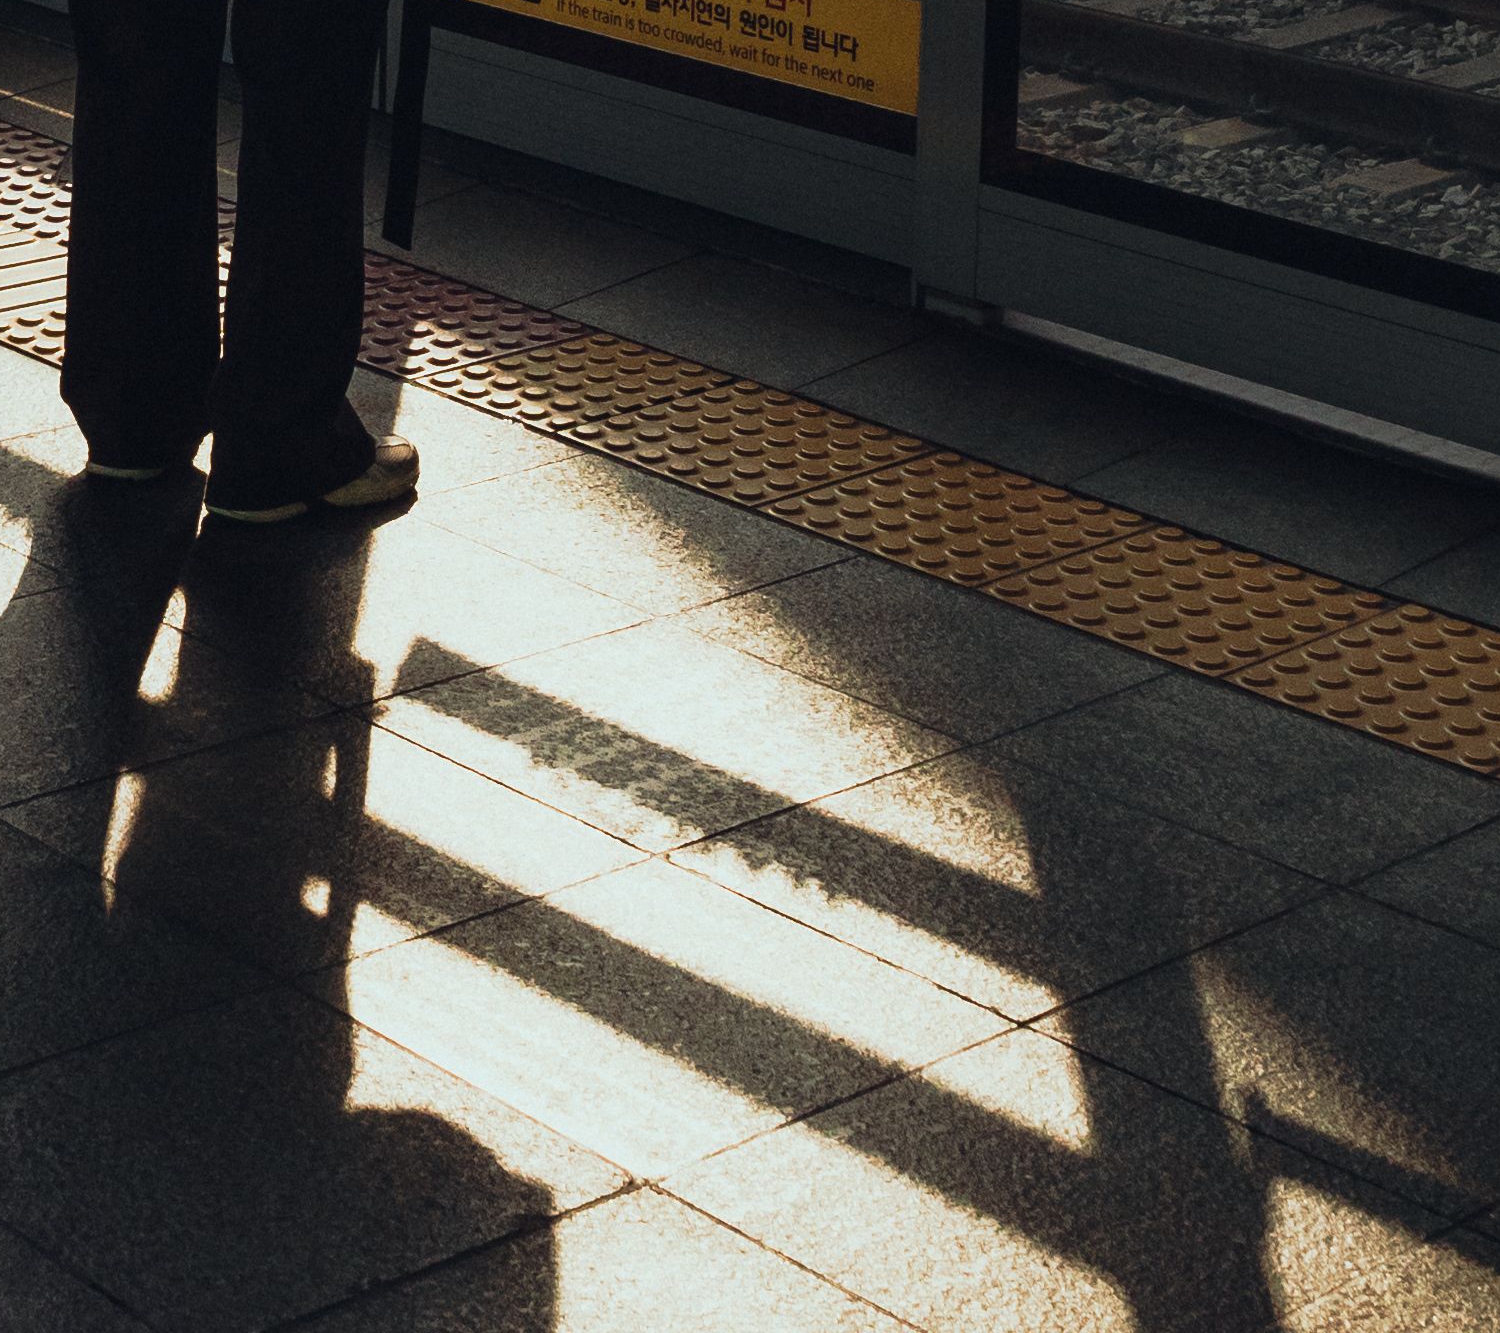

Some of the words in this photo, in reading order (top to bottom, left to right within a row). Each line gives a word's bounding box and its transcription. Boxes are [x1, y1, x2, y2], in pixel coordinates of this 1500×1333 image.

[591, 3, 623, 27] train
[624, 10, 636, 31] is
[638, 15, 662, 37] too
[663, 23, 727, 56] crowded,
[728, 40, 760, 62] wait
[761, 45, 782, 67] for
[784, 51, 808, 75] the
[810, 61, 843, 84] next
[846, 71, 876, 93] one
[738, 9, 795, 47] 원인이
[801, 25, 860, 62] 됩니다
